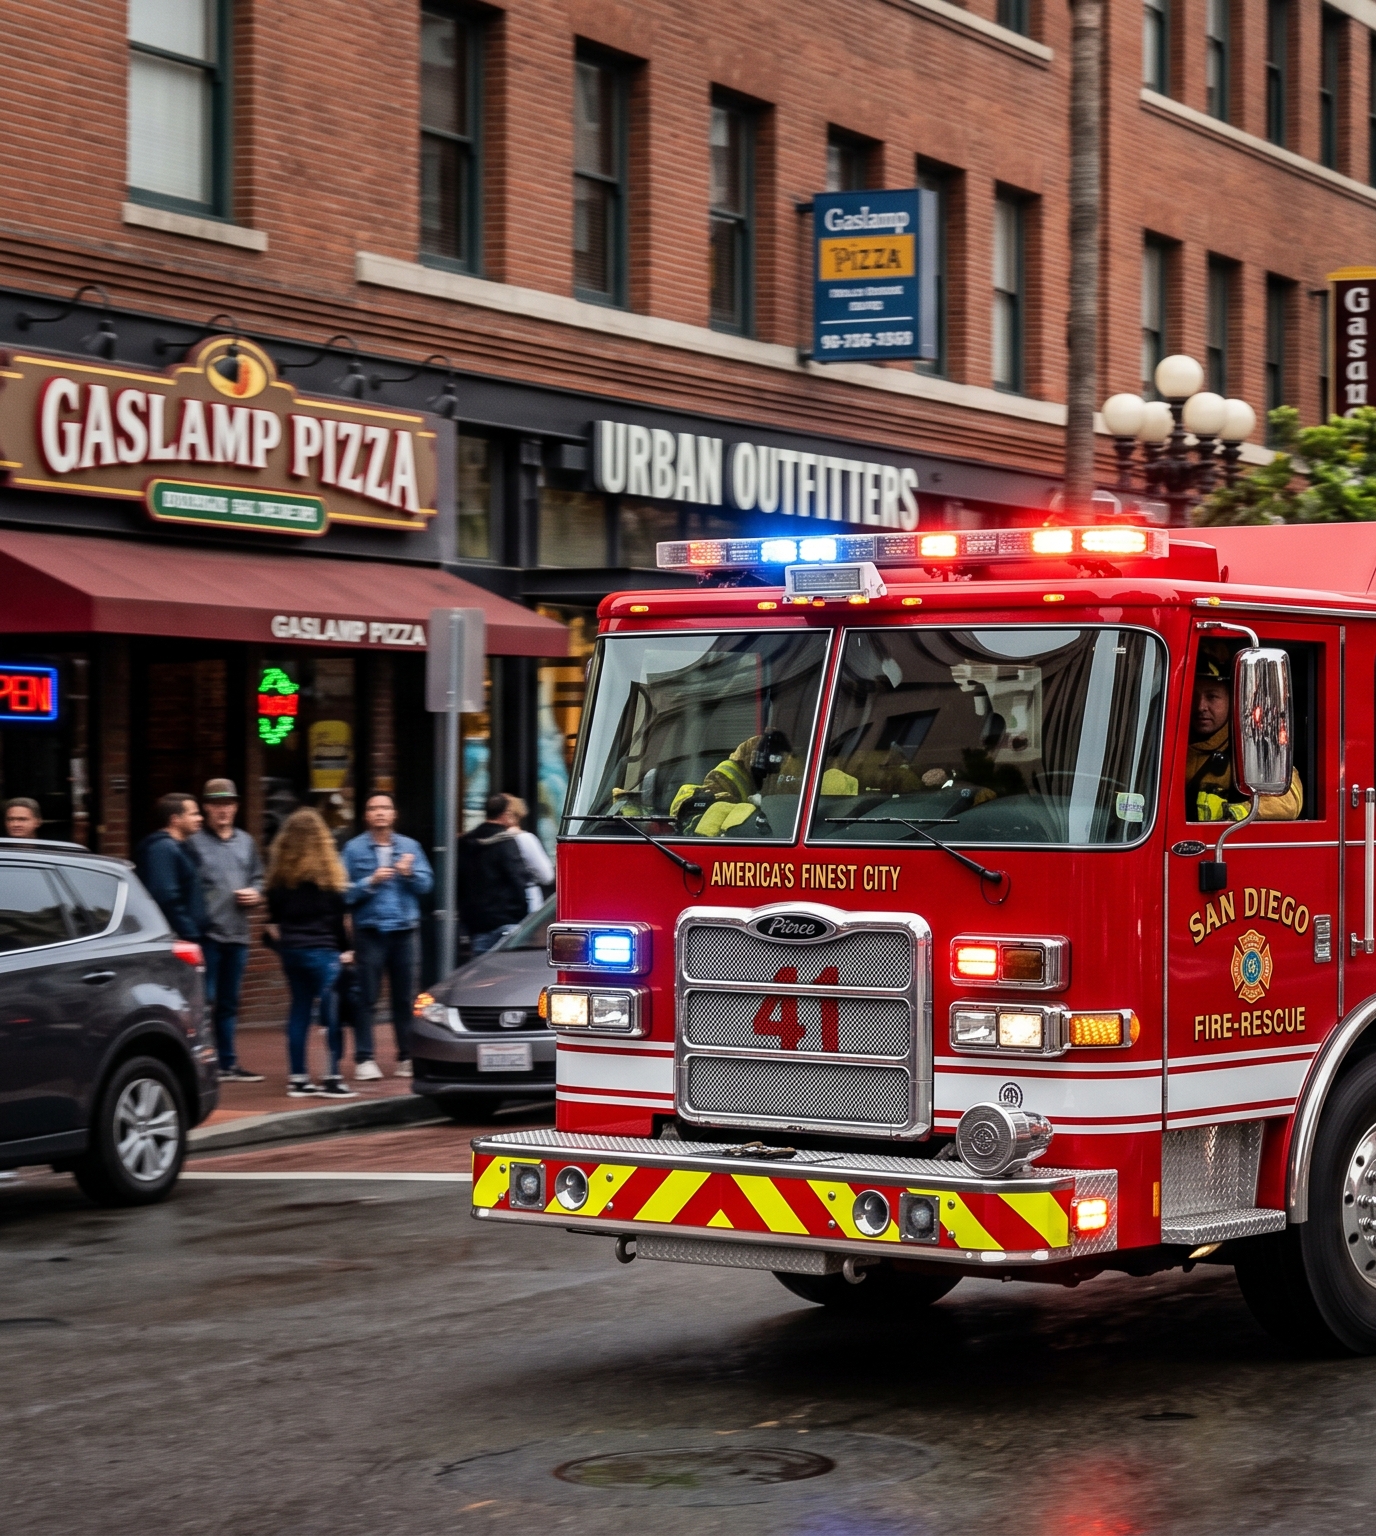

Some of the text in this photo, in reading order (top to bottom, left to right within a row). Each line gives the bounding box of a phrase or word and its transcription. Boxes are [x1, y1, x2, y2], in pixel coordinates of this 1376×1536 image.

[823, 206, 911, 234] Gaslamp
[40, 377, 420, 514] GASLAMP PIZZA
[597, 420, 920, 531] URBAN OUTFITTERS
[368, 621, 428, 646] PIZZA
[0, 674, 52, 712] PEN
[710, 861, 901, 891] AMERICA'S FINEST CITY
[1189, 887, 1310, 944] SAN DIEGO
[753, 965, 839, 1053] 41
[1194, 1006, 1306, 1041] FIRE-RESCUE
